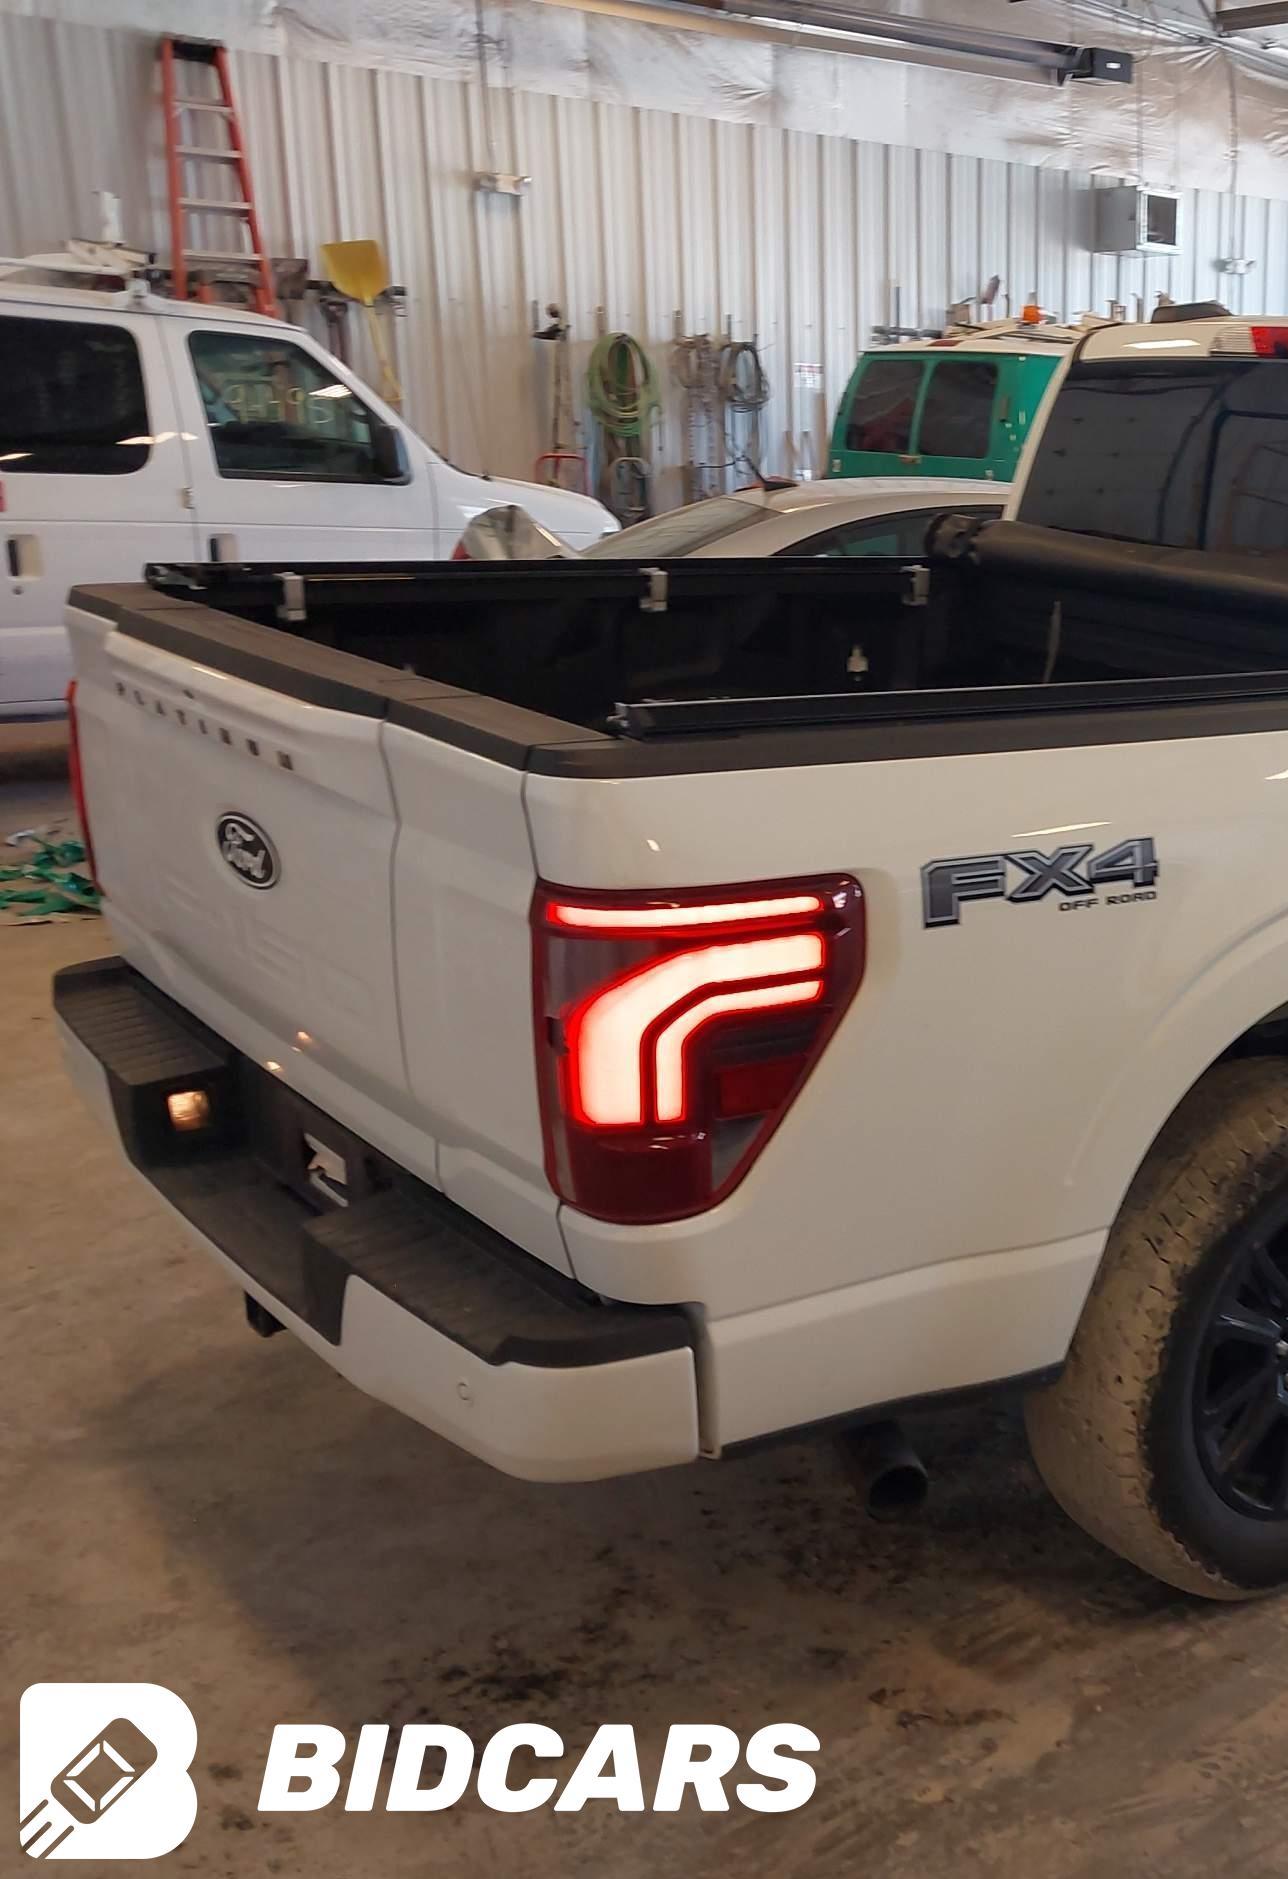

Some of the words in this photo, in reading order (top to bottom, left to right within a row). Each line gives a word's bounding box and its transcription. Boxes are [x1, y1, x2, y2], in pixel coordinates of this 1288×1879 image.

[920, 837, 1158, 928] FX4
[1059, 898, 1098, 911] OFF
[1106, 891, 1157, 905] ROAD
